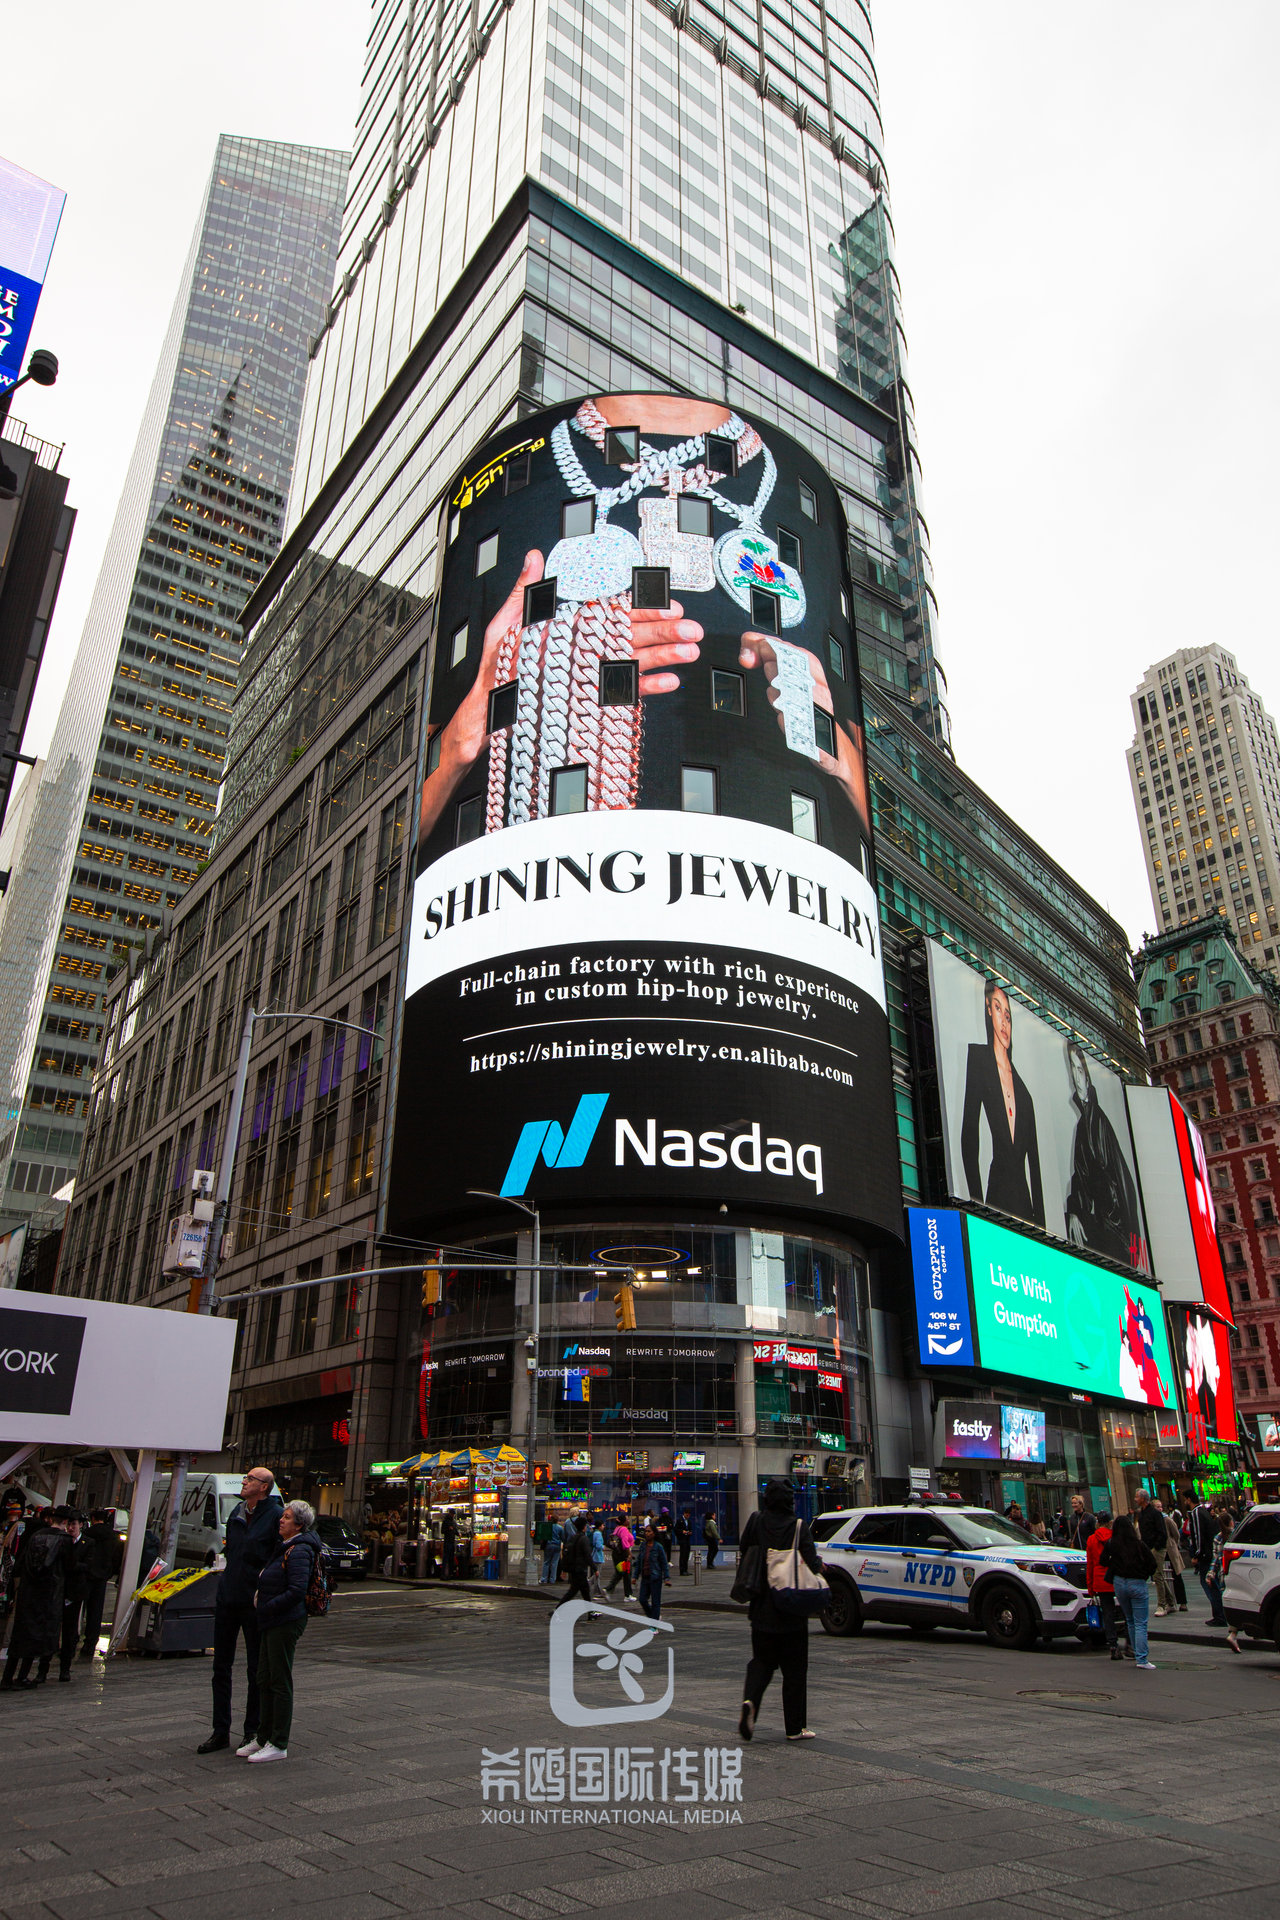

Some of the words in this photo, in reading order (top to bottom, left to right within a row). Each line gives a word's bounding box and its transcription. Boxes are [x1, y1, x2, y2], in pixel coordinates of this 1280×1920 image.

[424, 850, 646, 940] SHINING
[667, 851, 879, 960] JEWELRY
[459, 960, 561, 998] Full-chain
[569, 956, 656, 977] factory
[664, 956, 717, 975] with
[724, 960, 767, 984] rich
[774, 971, 860, 1014] experience
[515, 987, 536, 1006] in
[544, 980, 628, 1002] custom
[637, 978, 729, 1005] hip-hop
[736, 987, 817, 1019] jewelry.
[470, 1037, 854, 1087] https://shiningjewelry.en.alibaba.com
[614, 1117, 825, 1196] Nasdaq
[183, 1233, 202, 1243] 726156
[927, 1218, 943, 1300] GUMPTION
[990, 1263, 1018, 1292] Live
[1020, 1274, 1052, 1304] With
[928, 1322, 947, 1330] 45TH
[949, 1323, 961, 1331] ST
[929, 1312, 946, 1320] 106
[948, 1313, 957, 1321] W
[994, 1301, 1057, 1339] Gumption
[444, 1357, 467, 1367] REWRITE
[469, 1353, 505, 1364] TOMORROW
[578, 1346, 611, 1358] Nasdaq
[626, 1348, 664, 1357] REWRITE
[668, 1348, 716, 1358] TOMORROW
[623, 1407, 668, 1423] Nasdaq
[1012, 1412, 1035, 1432] STAY
[953, 1418, 993, 1441] fastly.
[1009, 1431, 1039, 1457] SAFE
[985, 1555, 1006, 1564] POLICE
[1252, 1550, 1265, 1559] 5407
[904, 1562, 956, 1587] NYPD
